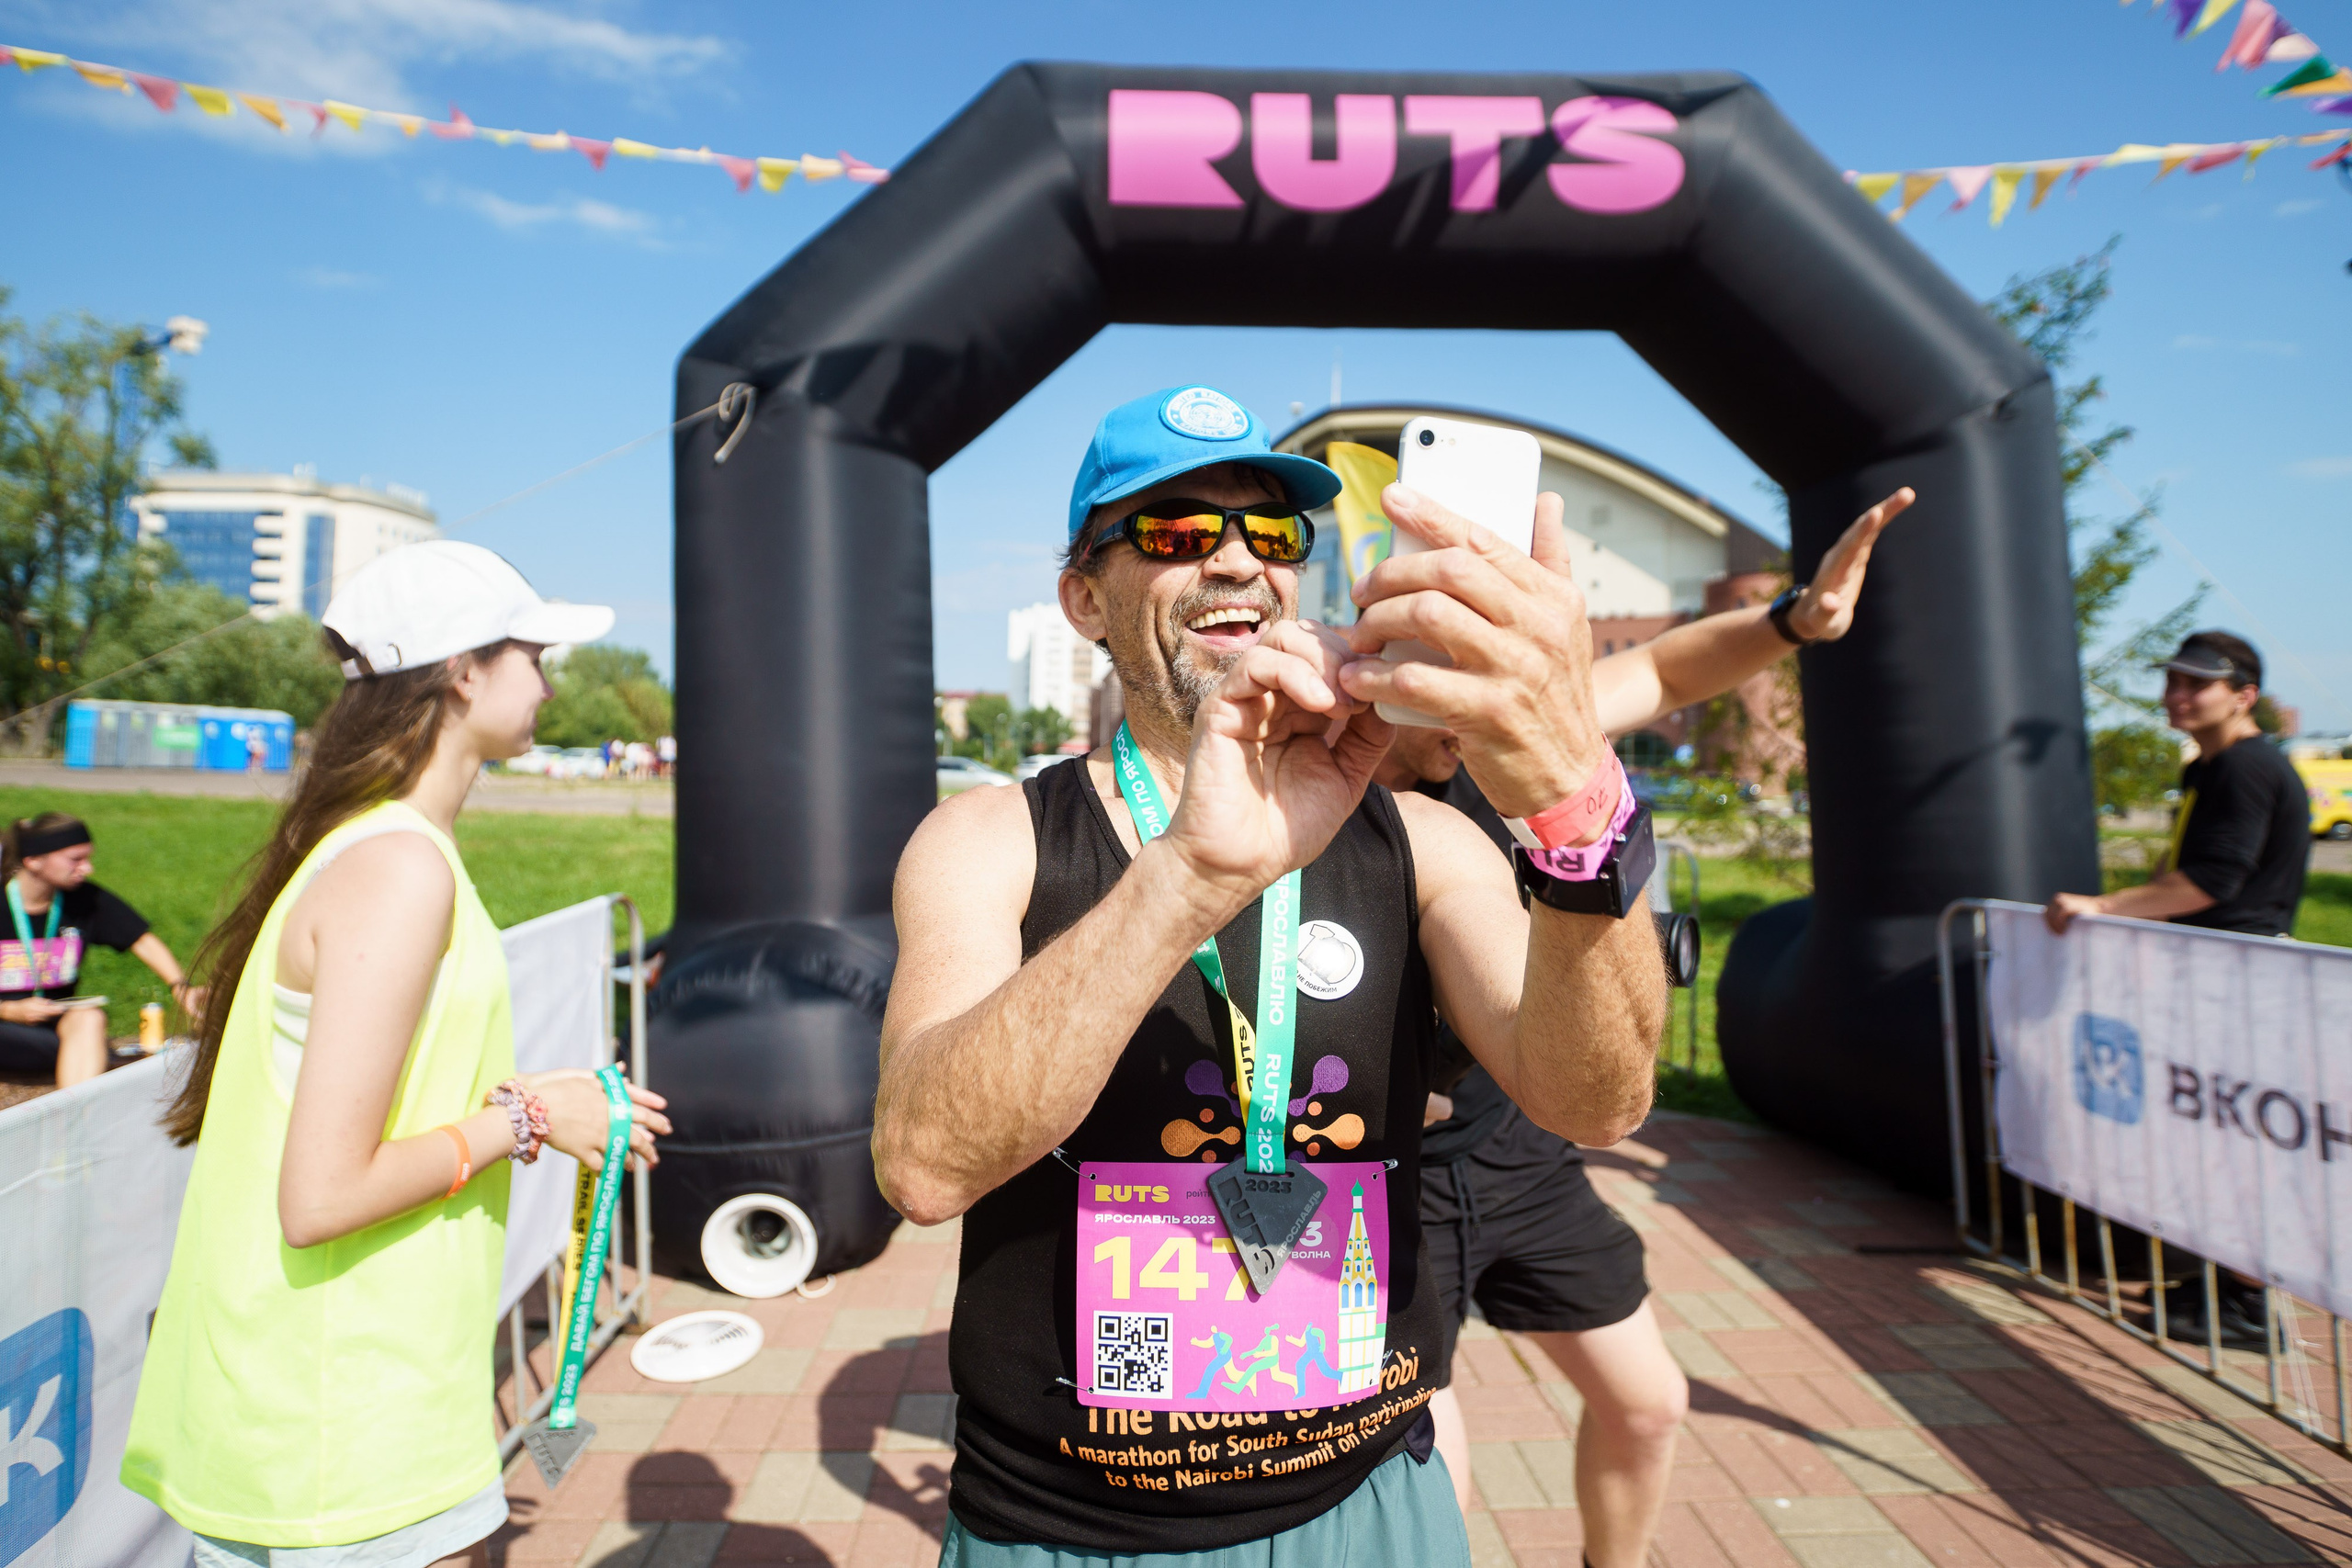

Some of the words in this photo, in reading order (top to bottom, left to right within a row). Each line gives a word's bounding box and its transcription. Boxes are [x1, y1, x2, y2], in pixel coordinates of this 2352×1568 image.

[1108, 89, 1686, 215] RUTS
[1131, 780, 1151, 804] ПО
[1304, 979, 1338, 993] ПОБЕЖИМ
[1260, 1054, 1281, 1122] RUTS
[594, 1134, 627, 1230] ЯРОСЛАВЛЮ
[1094, 1184, 1170, 1203] RUTS
[1245, 1179, 1292, 1194] 2023
[1094, 1213, 1181, 1224] ЯРОСЛАВЛЬ
[1182, 1215, 1216, 1224] 2023
[1276, 1190, 1321, 1258] ЯРОСЛАВЛЬ
[1298, 1221, 1323, 1247] 3
[590, 1230, 606, 1253] ПО
[1291, 1250, 1331, 1259] ВОЛНА
[581, 1254, 603, 1303] БЕГОМ
[571, 1302, 591, 1352] ДАВАЙ
[1059, 1437, 1074, 1457] A
[1078, 1444, 1182, 1467] marathon
[1188, 1439, 1220, 1463] for
[1226, 1430, 1288, 1458] South
[1295, 1421, 1354, 1443] Sudan
[1105, 1471, 1128, 1488] to
[1132, 1472, 1170, 1492] the
[1174, 1462, 1254, 1490] Nairobi
[1261, 1441, 1337, 1477] Summit
[1338, 1432, 1361, 1453] on
